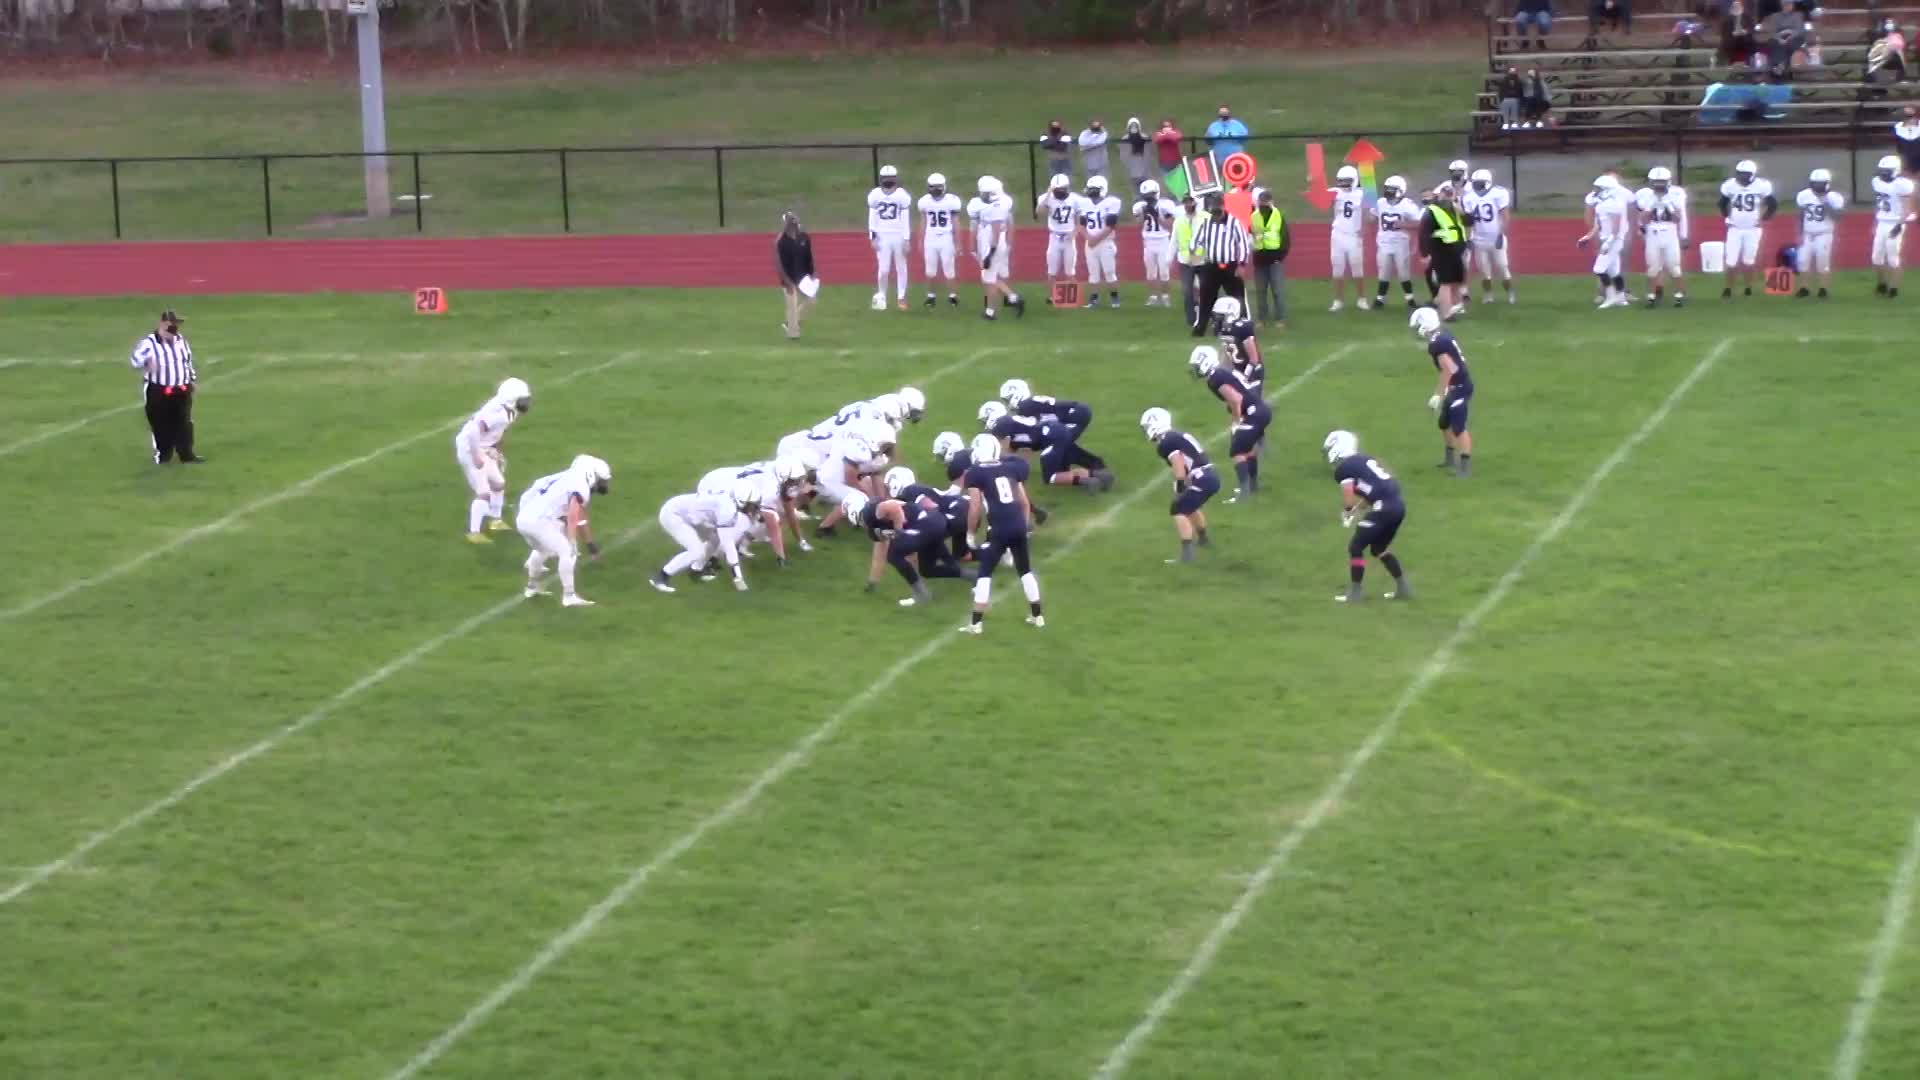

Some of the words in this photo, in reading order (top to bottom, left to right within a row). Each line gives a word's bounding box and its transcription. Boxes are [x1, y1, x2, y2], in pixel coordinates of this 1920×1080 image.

[878, 202, 898, 220] 23
[1343, 201, 1354, 219] 6
[1471, 203, 1494, 222] 43
[1732, 194, 1755, 213] 49
[928, 211, 948, 228] 36
[1052, 206, 1072, 224] 47
[1767, 270, 1791, 292] 40
[416, 289, 439, 310] 20
[1056, 284, 1077, 304] 30
[994, 476, 1014, 504] 8
